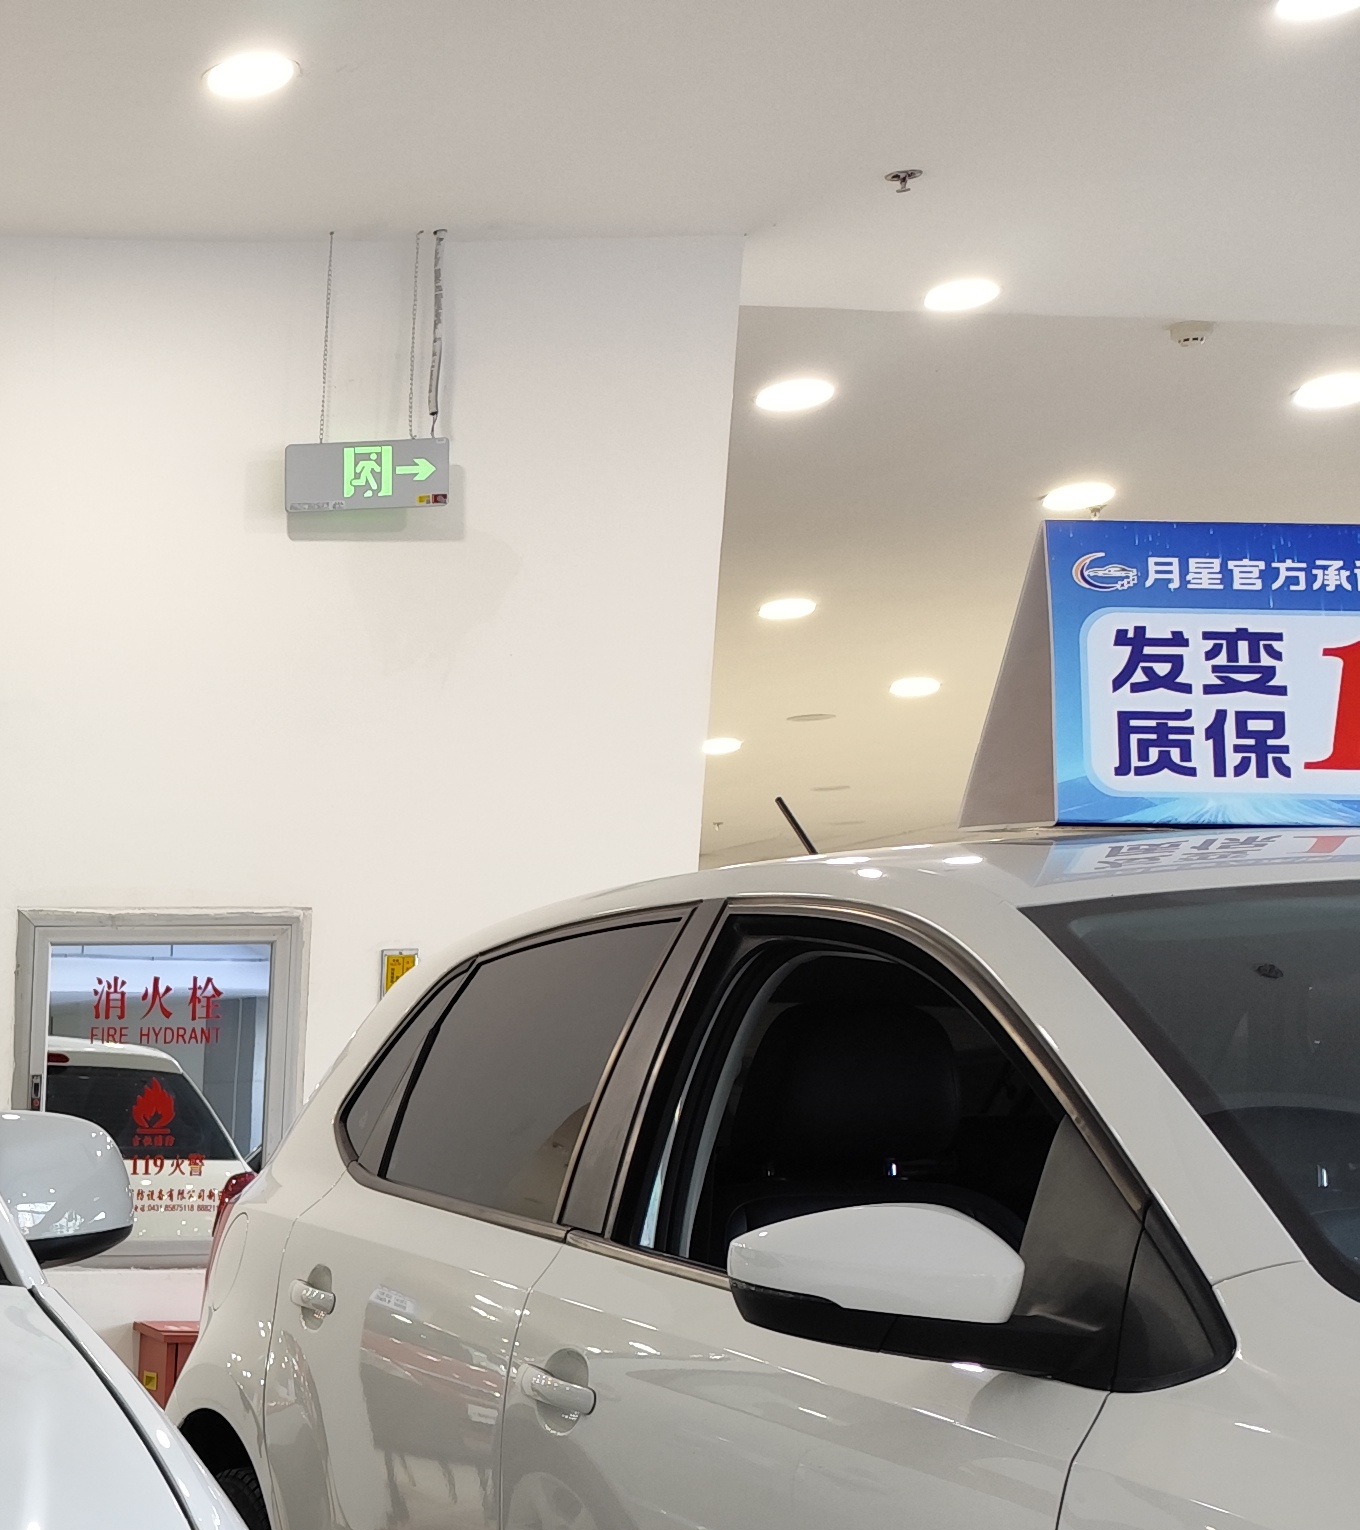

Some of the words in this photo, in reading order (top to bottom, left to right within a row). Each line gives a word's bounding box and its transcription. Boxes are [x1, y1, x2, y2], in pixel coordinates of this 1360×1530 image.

[1145, 556, 1360, 592] 月星官方承
[1112, 625, 1288, 697] 发变
[1114, 708, 1291, 779] 质保
[92, 975, 224, 1021] 消火栓
[90, 1026, 129, 1044] FIRE
[139, 1026, 220, 1044] HYDRANT
